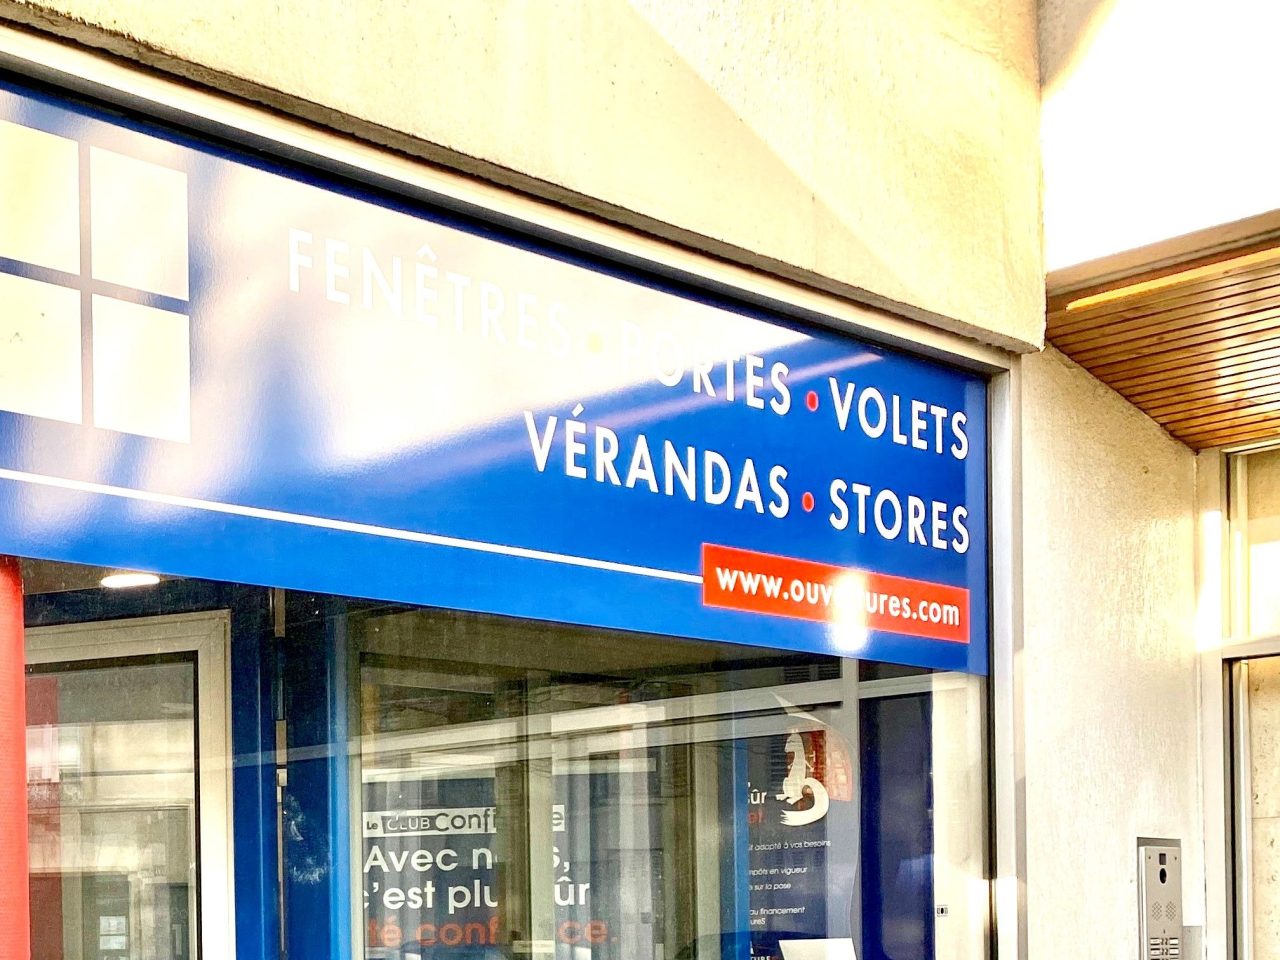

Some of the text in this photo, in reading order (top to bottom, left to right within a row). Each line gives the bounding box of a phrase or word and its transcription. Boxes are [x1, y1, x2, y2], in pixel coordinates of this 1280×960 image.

[287, 227, 571, 361] FENÊTRES
[829, 377, 969, 460] VOLETS
[523, 403, 970, 554] VÉRANDAS STORES
[715, 566, 961, 628] www.ouvures.com
[365, 805, 565, 833] Le CLUB Confie
[363, 844, 570, 873] Avec ns,
[448, 878, 498, 914] plu
[554, 875, 591, 906] ûr
[415, 914, 618, 947] confce.
